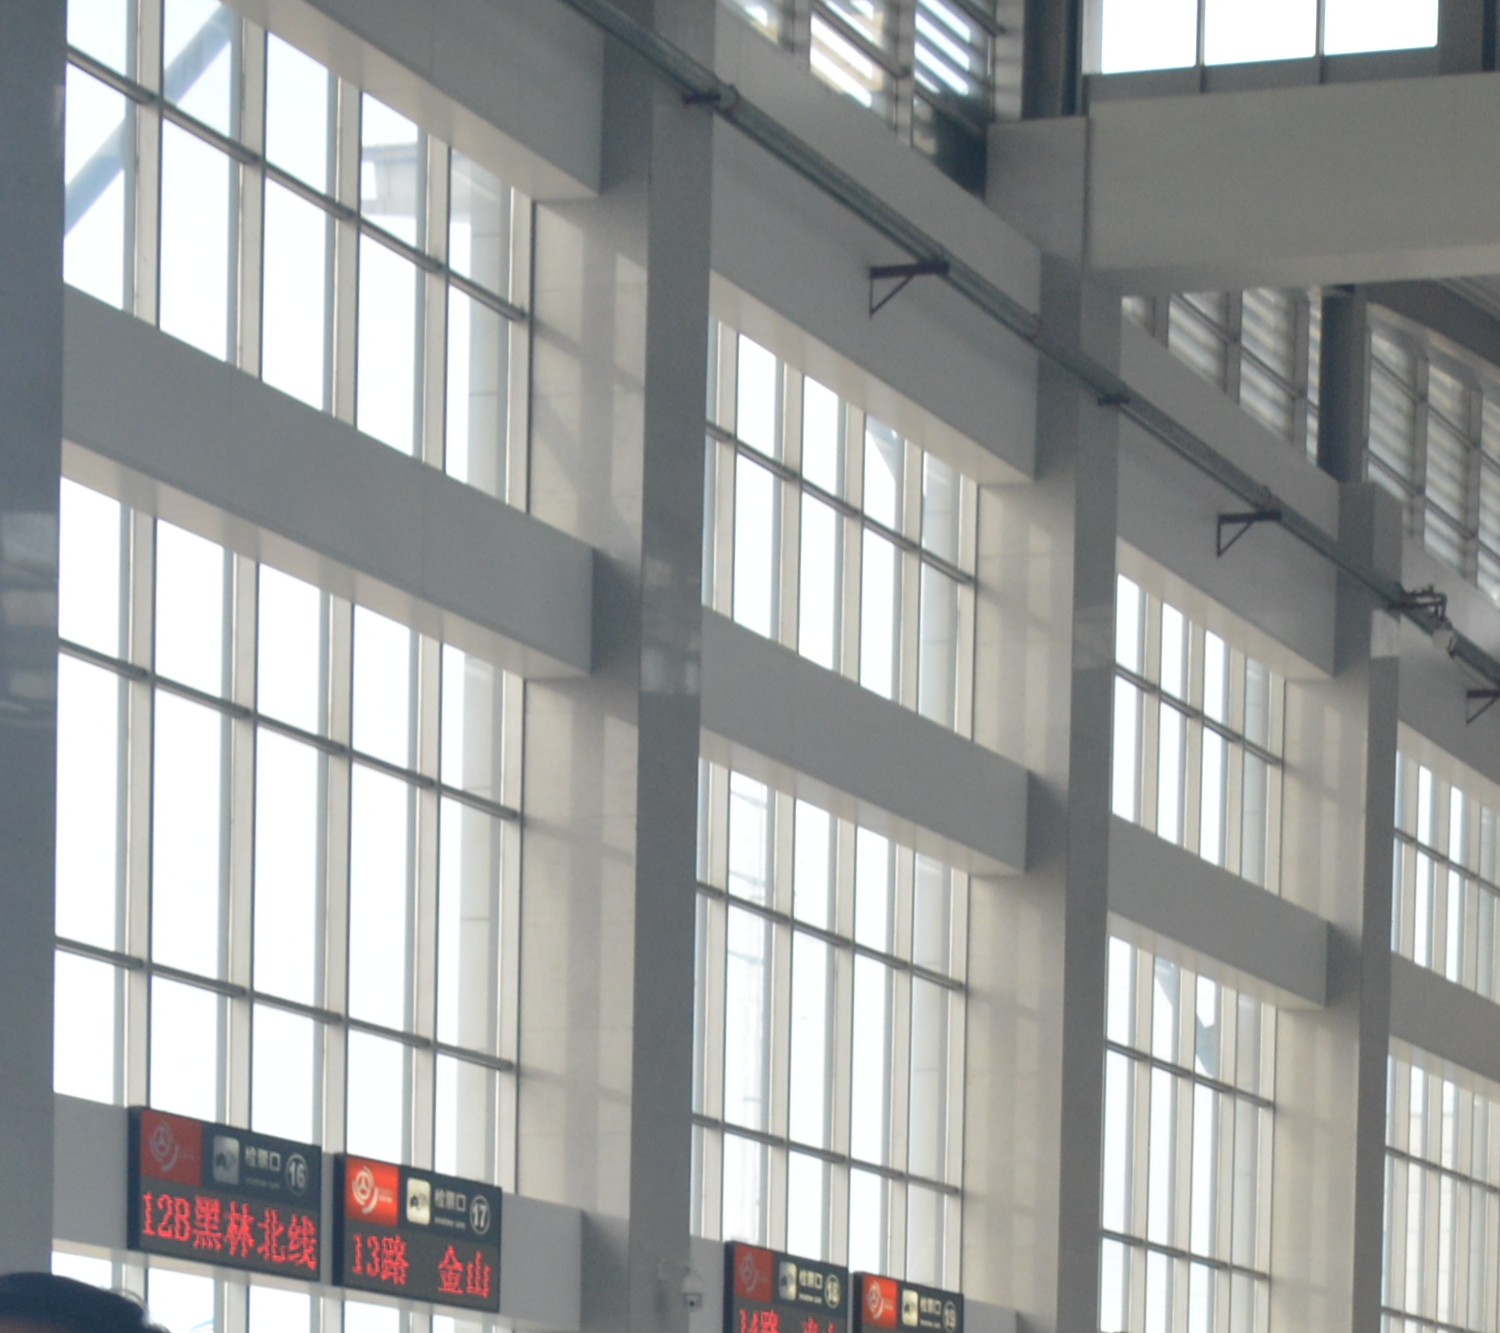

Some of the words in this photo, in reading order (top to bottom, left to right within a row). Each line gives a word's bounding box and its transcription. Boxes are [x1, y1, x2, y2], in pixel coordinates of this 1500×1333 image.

[245, 1145, 282, 1172] 检票口
[288, 1160, 306, 1189] 16
[472, 1203, 488, 1228] 17
[142, 1191, 317, 1271] 12B黑林北线
[352, 1232, 410, 1286] 13路
[437, 1244, 491, 1298] 金山
